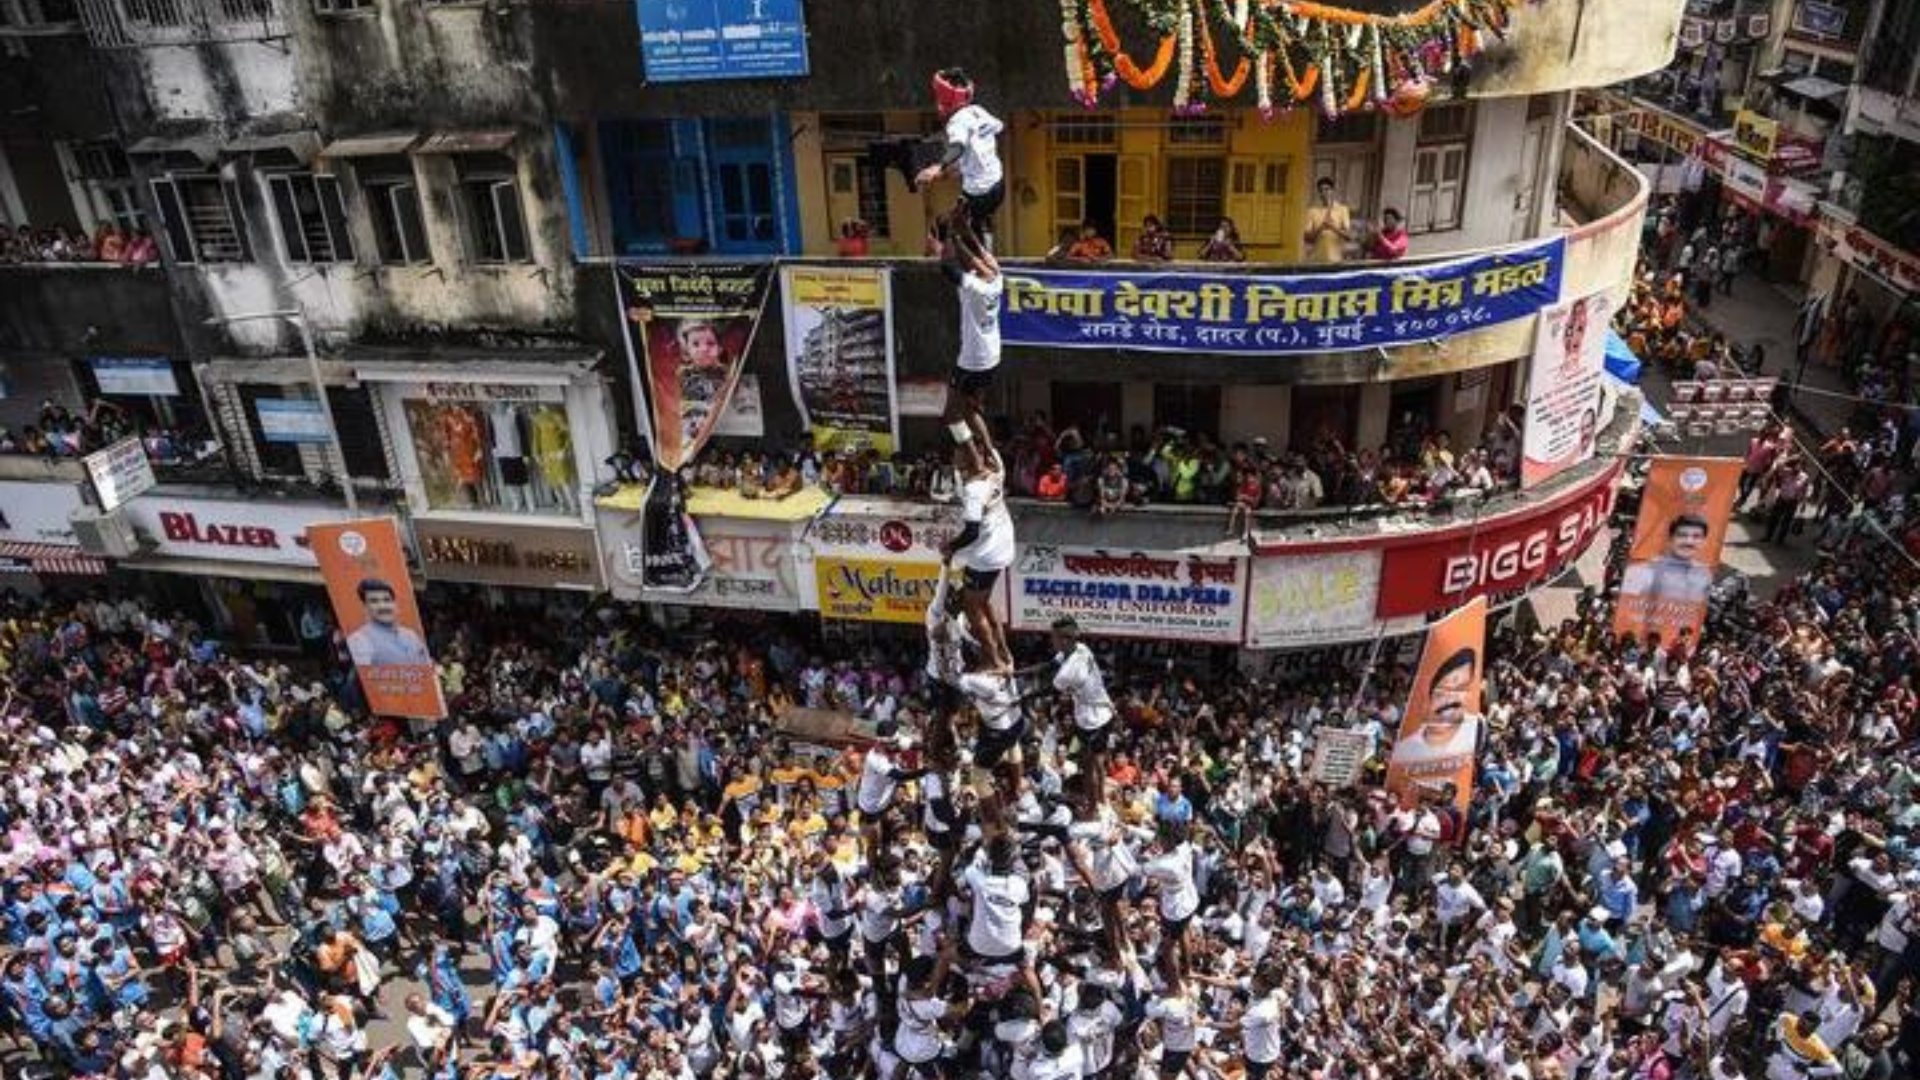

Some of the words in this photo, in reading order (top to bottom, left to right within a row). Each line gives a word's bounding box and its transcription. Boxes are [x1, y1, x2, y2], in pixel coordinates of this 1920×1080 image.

[1003, 276, 1105, 317] जिवा
[1244, 283, 1382, 323] निवास
[1390, 274, 1465, 314] मित्र
[1196, 325, 1249, 345] दादर
[158, 511, 281, 549] BLAZER
[1442, 529, 1548, 594] BIGG
[840, 564, 939, 602] Mahav
[1023, 578, 1131, 601] EXCELSIOR
[1137, 583, 1232, 606] DRAPERS
[1037, 596, 1109, 611] SCHOOL
[1117, 599, 1218, 616] UNIFORMS
[1114, 612, 1137, 623] FOR
[1140, 614, 1164, 625] NEW
[1167, 616, 1198, 627] BORN
[1200, 617, 1231, 629] BABY
